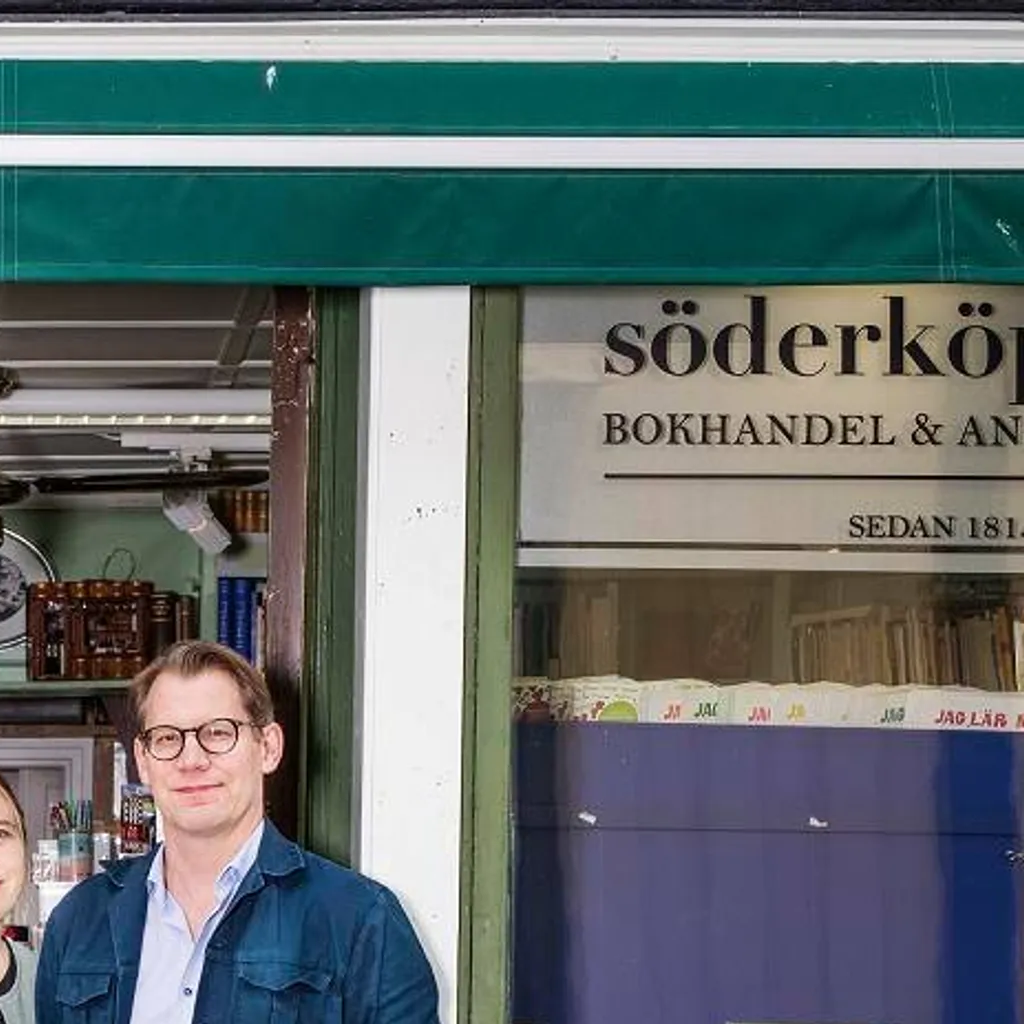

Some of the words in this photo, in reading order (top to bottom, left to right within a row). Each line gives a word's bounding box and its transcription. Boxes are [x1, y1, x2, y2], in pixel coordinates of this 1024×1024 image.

[603, 294, 1024, 405] söderkö
[602, 412, 895, 447] BOKHANDEL
[910, 413, 943, 447] &
[849, 514, 957, 539] SEDAN
[968, 516, 1024, 540] 181
[934, 709, 966, 725] JAG
[969, 709, 1009, 728] LÄR
